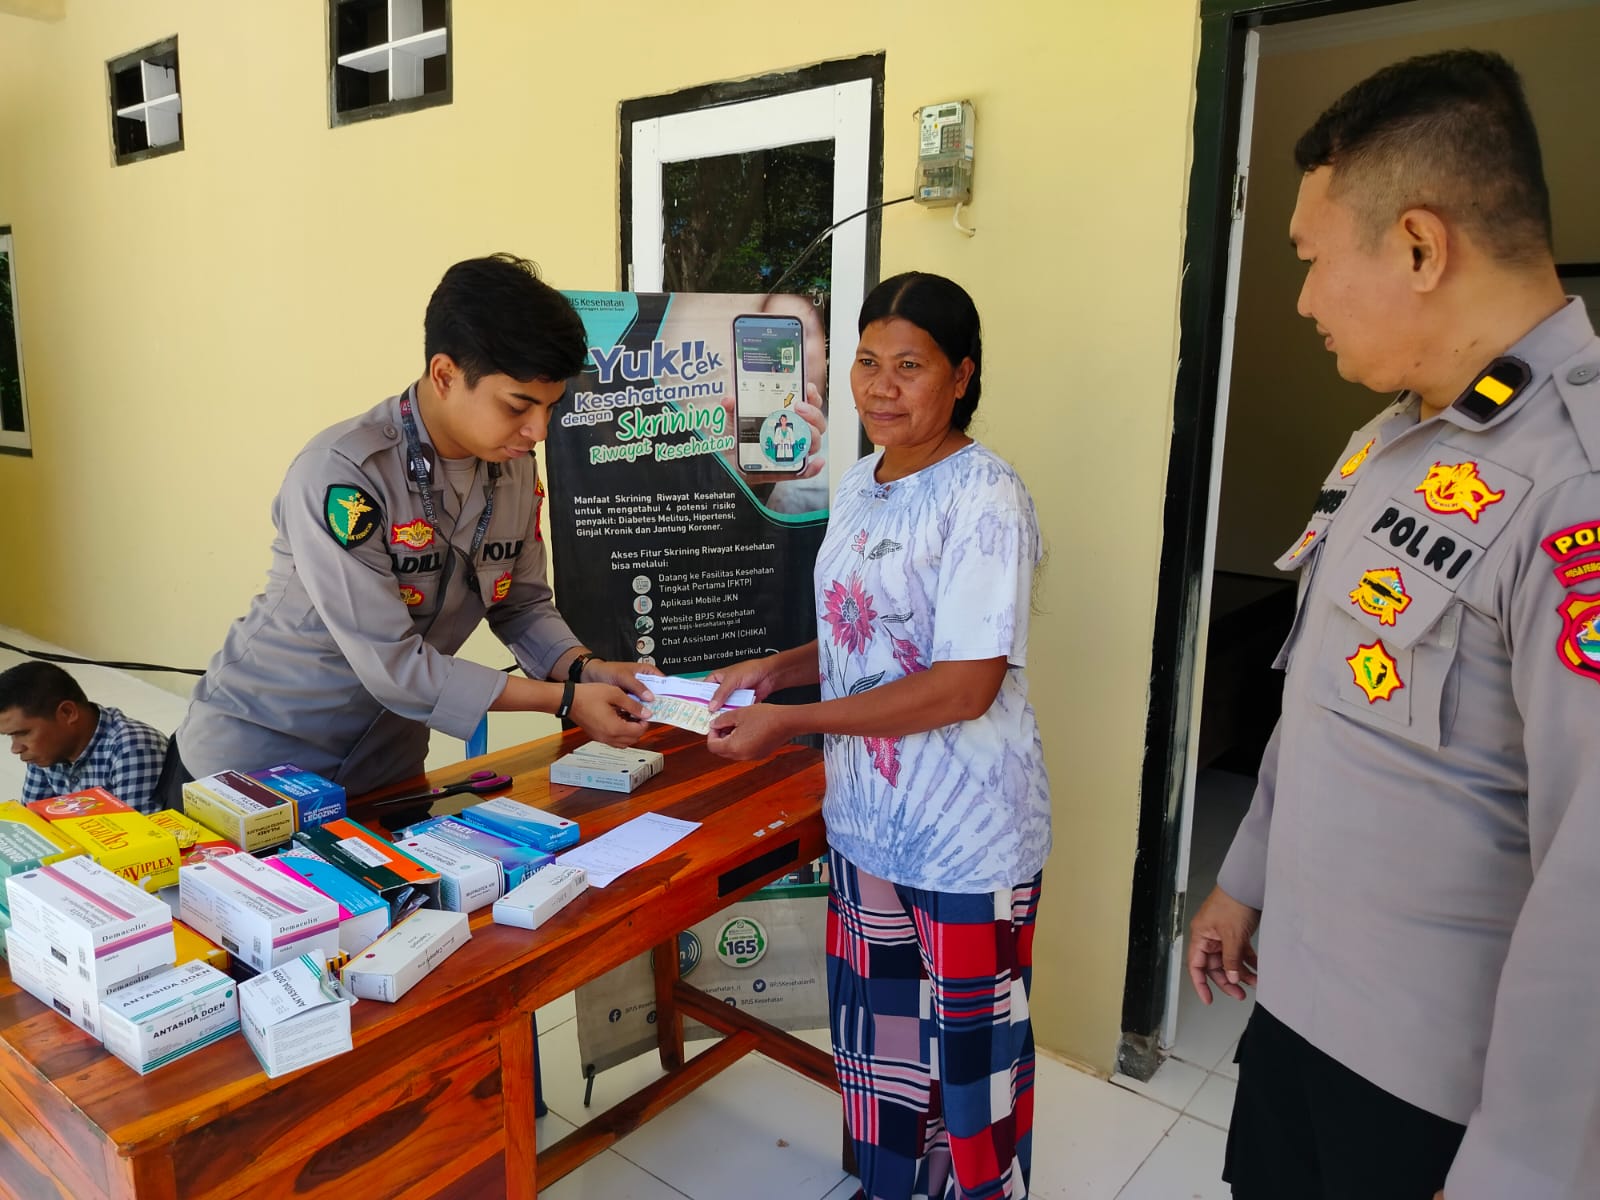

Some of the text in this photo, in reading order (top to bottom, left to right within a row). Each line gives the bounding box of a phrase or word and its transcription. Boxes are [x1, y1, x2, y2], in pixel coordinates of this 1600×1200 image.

[581, 298, 624, 307] Kesehatan
[591, 340, 705, 383] Yuk!!
[681, 351, 723, 381] Cek
[576, 381, 724, 411] Kesehatanmu
[562, 411, 612, 427] dengan
[616, 406, 726, 440] Skrining
[591, 437, 735, 464] Riwayat Kesehatan
[574, 492, 736, 504] Manfaat Skrining Riwayat Kesehatan
[574, 506, 602, 515] untuk
[607, 505, 661, 515] mengetahui
[676, 502, 708, 513] potensi
[712, 502, 736, 510] risiko
[575, 512, 736, 527] penyakit: Diabetes Melitus, Hipertensi,
[576, 523, 723, 537] Ginjal Kronik dan Jantung Koroner.
[611, 543, 775, 559] Akses Fitur Skrining Riwayat Kesehatan
[1371, 507, 1473, 580] POLRI
[611, 559, 669, 570] bisa melalui:
[658, 567, 774, 583] Datang ke Fasilitas Kesehatan
[659, 577, 752, 593] Tingkat Pertama (FKTP)
[660, 593, 738, 608] Aplikasi Mobile JKN
[660, 609, 755, 624] Website BPJS Kesehatan
[661, 627, 767, 646] Chat Assistant JKN (CHIKA)
[662, 647, 762, 665] Atau scan barcode berikut
[102, 922, 146, 942] Demacolin
[280, 918, 318, 933] Demacolin
[726, 939, 756, 955] 165
[106, 974, 149, 996] Demacolin
[123, 969, 211, 1007] ANTASIDA DOEN
[272, 969, 308, 1007] ANTASIDA DOEN
[153, 1001, 226, 1039] ANTASIDA DOEN
